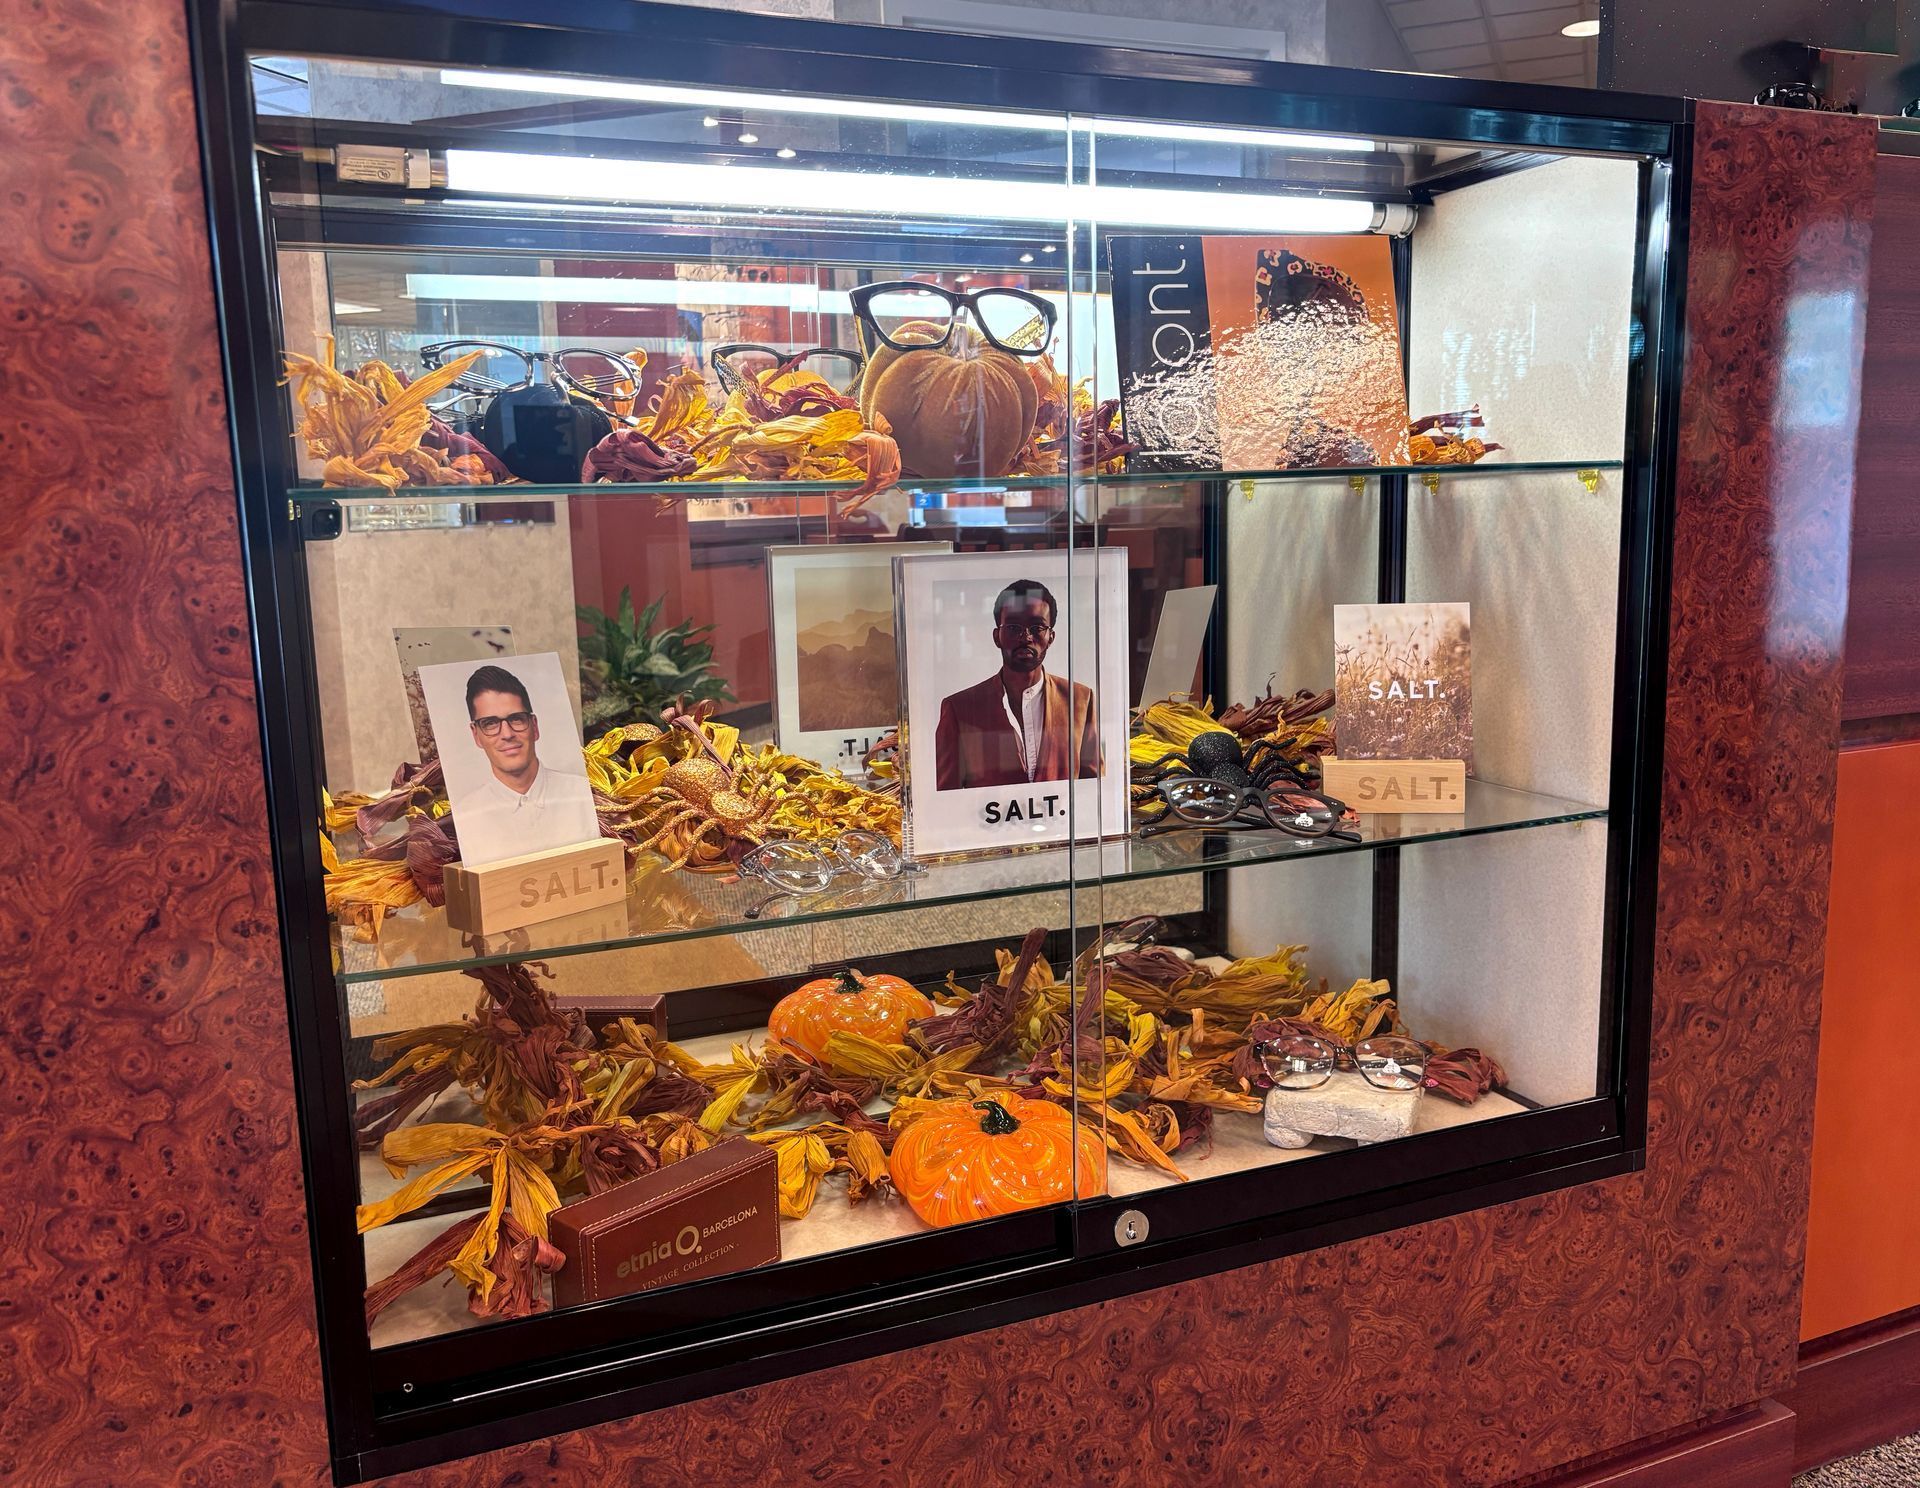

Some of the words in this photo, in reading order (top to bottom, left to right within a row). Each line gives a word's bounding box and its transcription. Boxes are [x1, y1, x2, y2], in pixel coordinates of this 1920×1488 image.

[1368, 679, 1446, 700] SALT.
[1358, 776, 1457, 800] SALT.
[985, 795, 1066, 824] SALT.
[519, 860, 619, 908] SALT.
[616, 1241, 673, 1279] etnia
[702, 1205, 758, 1239] BARCELONA
[683, 1242, 735, 1272] COLLECTION
